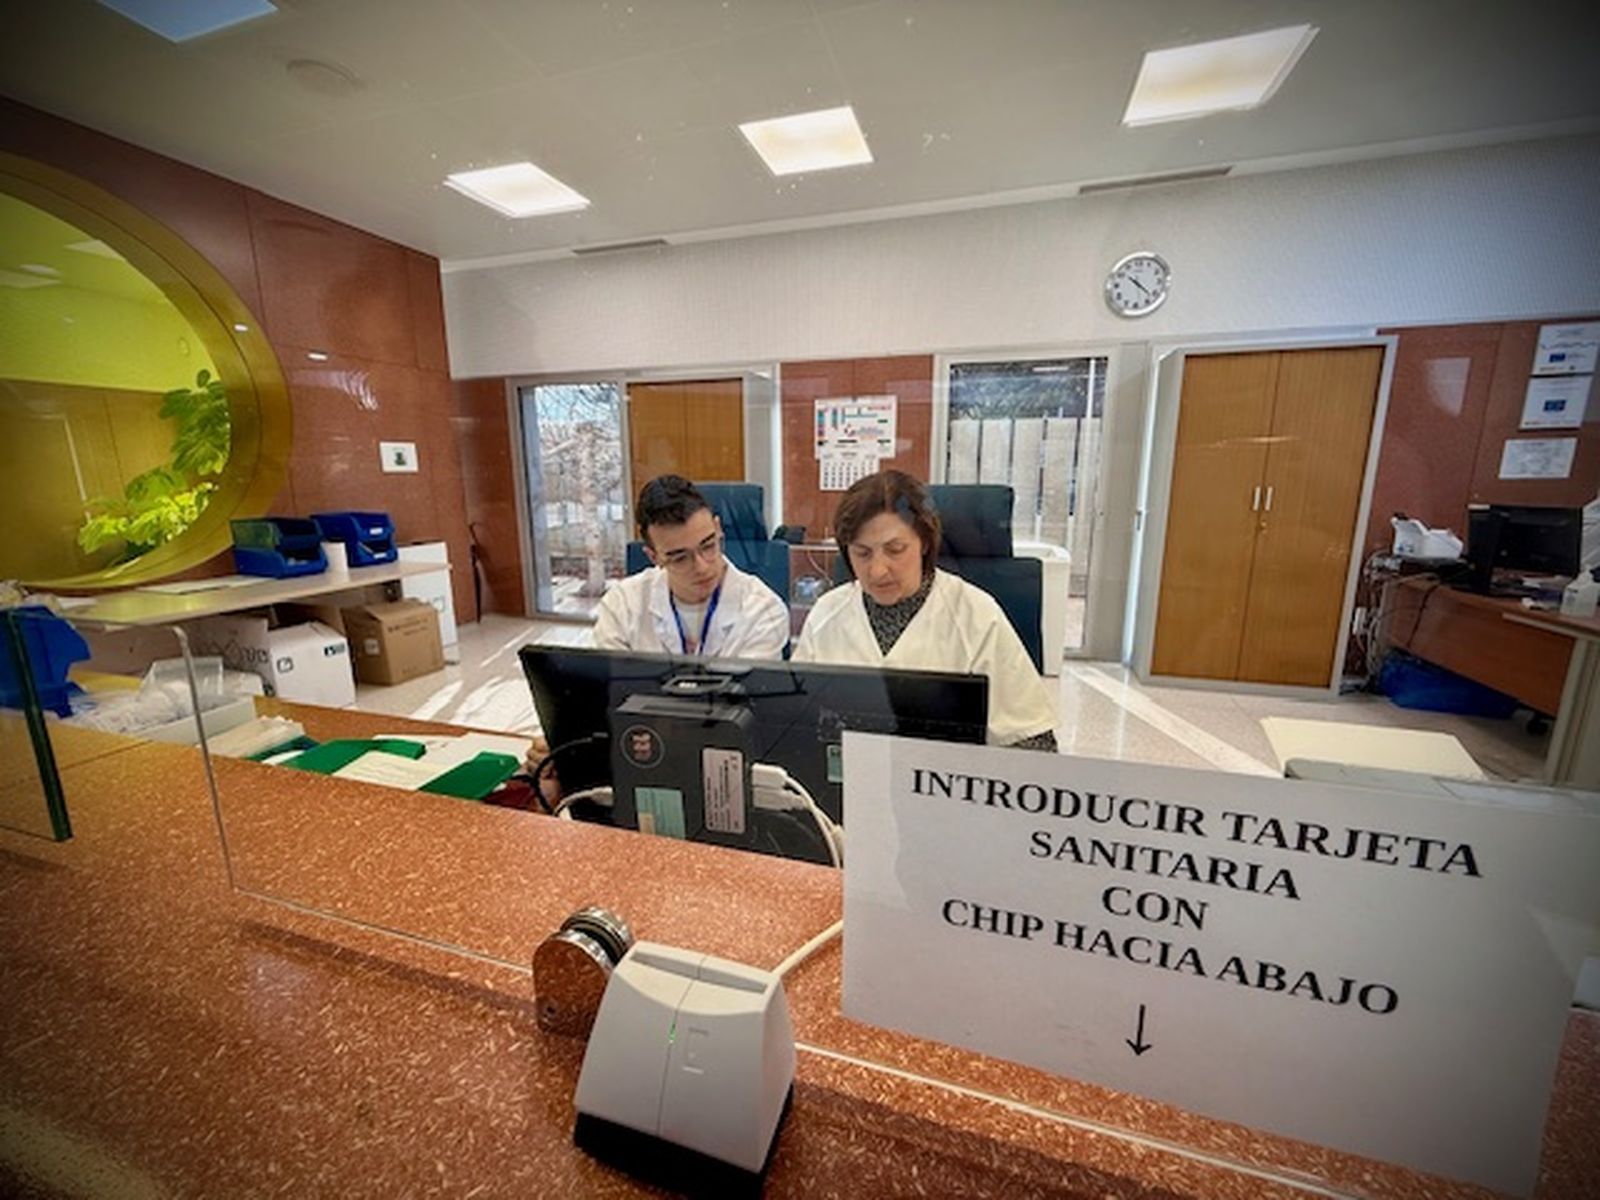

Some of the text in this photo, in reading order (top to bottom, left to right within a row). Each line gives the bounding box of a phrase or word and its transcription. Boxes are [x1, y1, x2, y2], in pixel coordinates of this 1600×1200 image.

[911, 768, 1483, 878] INTRODUCIR TARJETA
[1029, 831, 1301, 901] SANITARIA
[1101, 887, 1208, 931] CON
[942, 899, 1400, 1016] CHIP HACIA ABAJO
